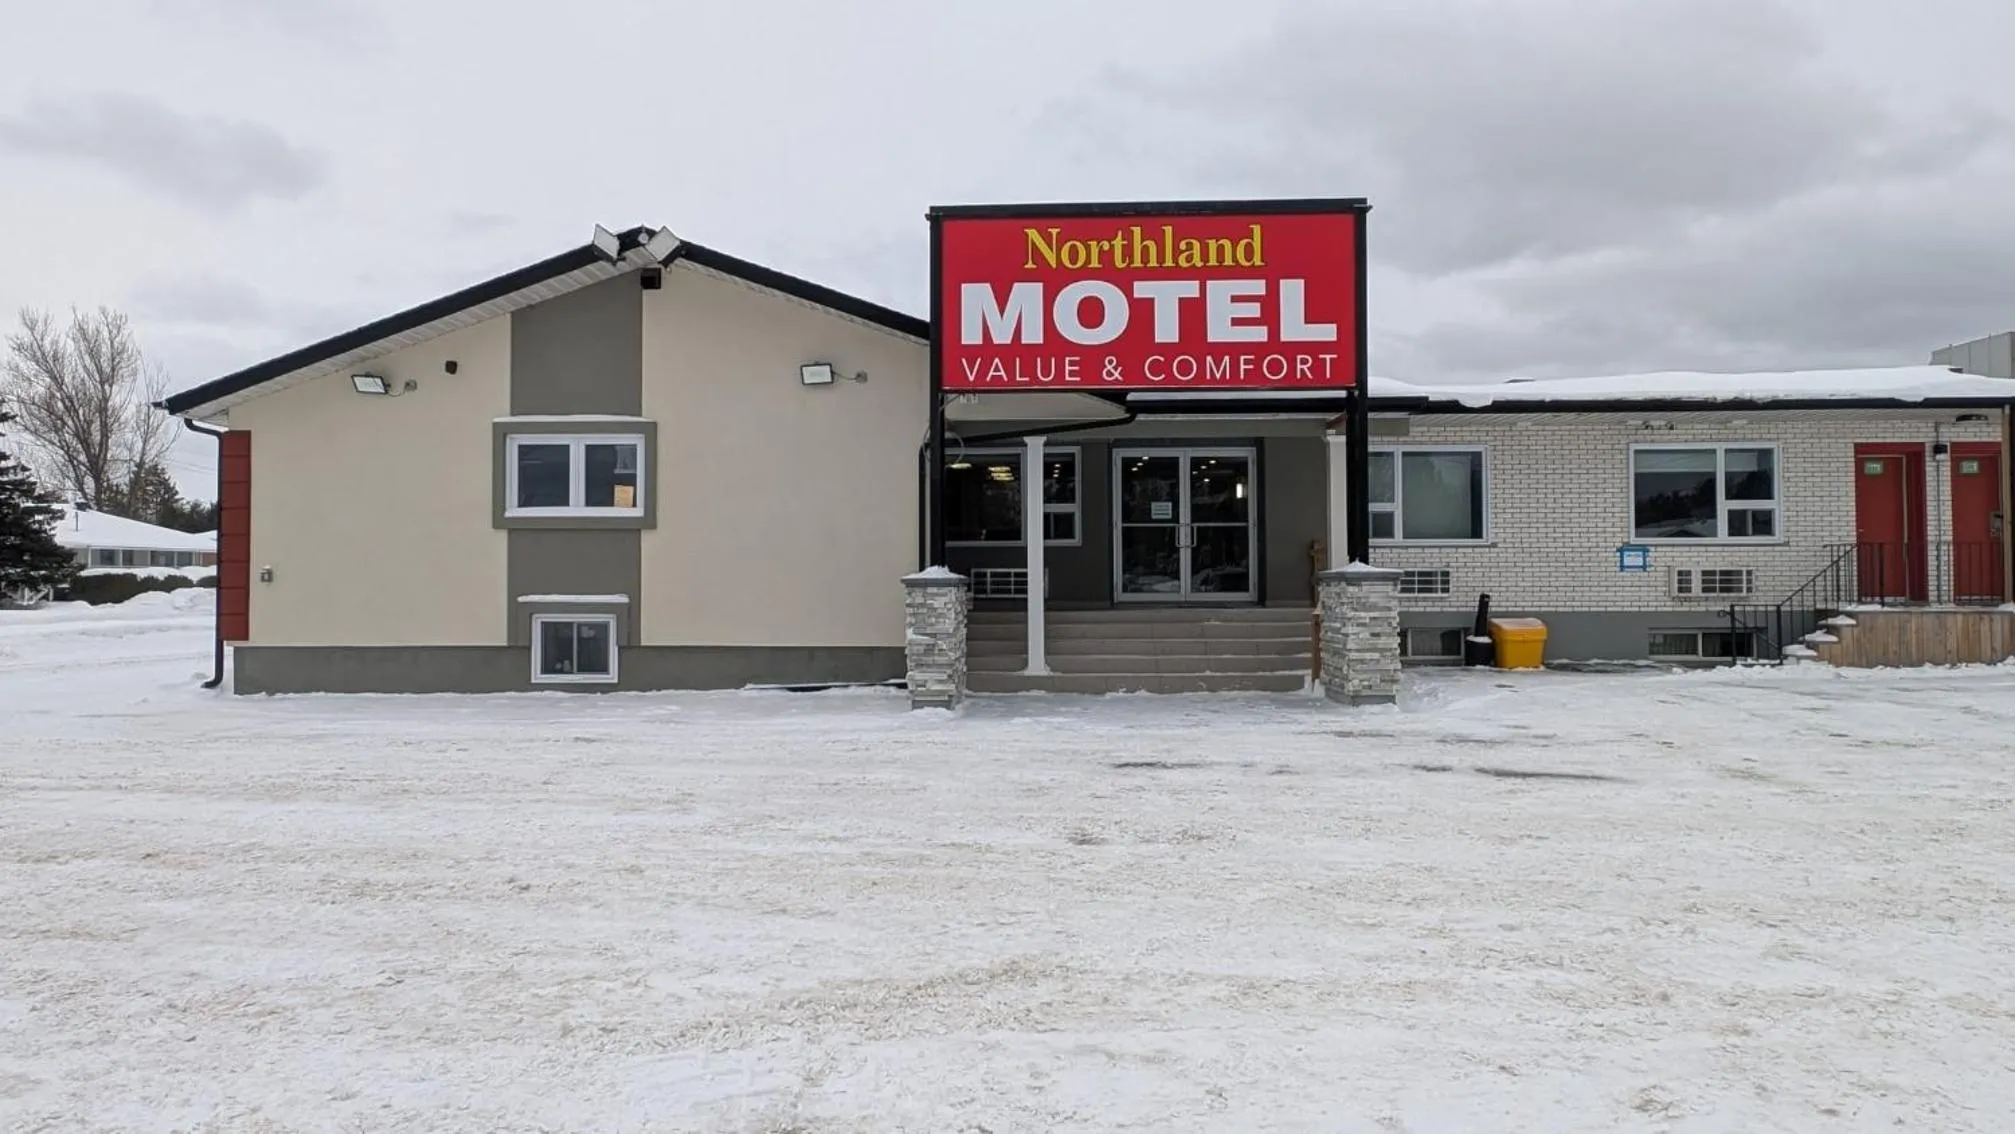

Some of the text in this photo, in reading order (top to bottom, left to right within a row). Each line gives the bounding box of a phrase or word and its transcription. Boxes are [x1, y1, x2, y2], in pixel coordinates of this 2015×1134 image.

[1023, 224, 1265, 269] Northland
[960, 278, 1338, 346] MOTEL
[961, 354, 1338, 382] VALUE & COMFORT
